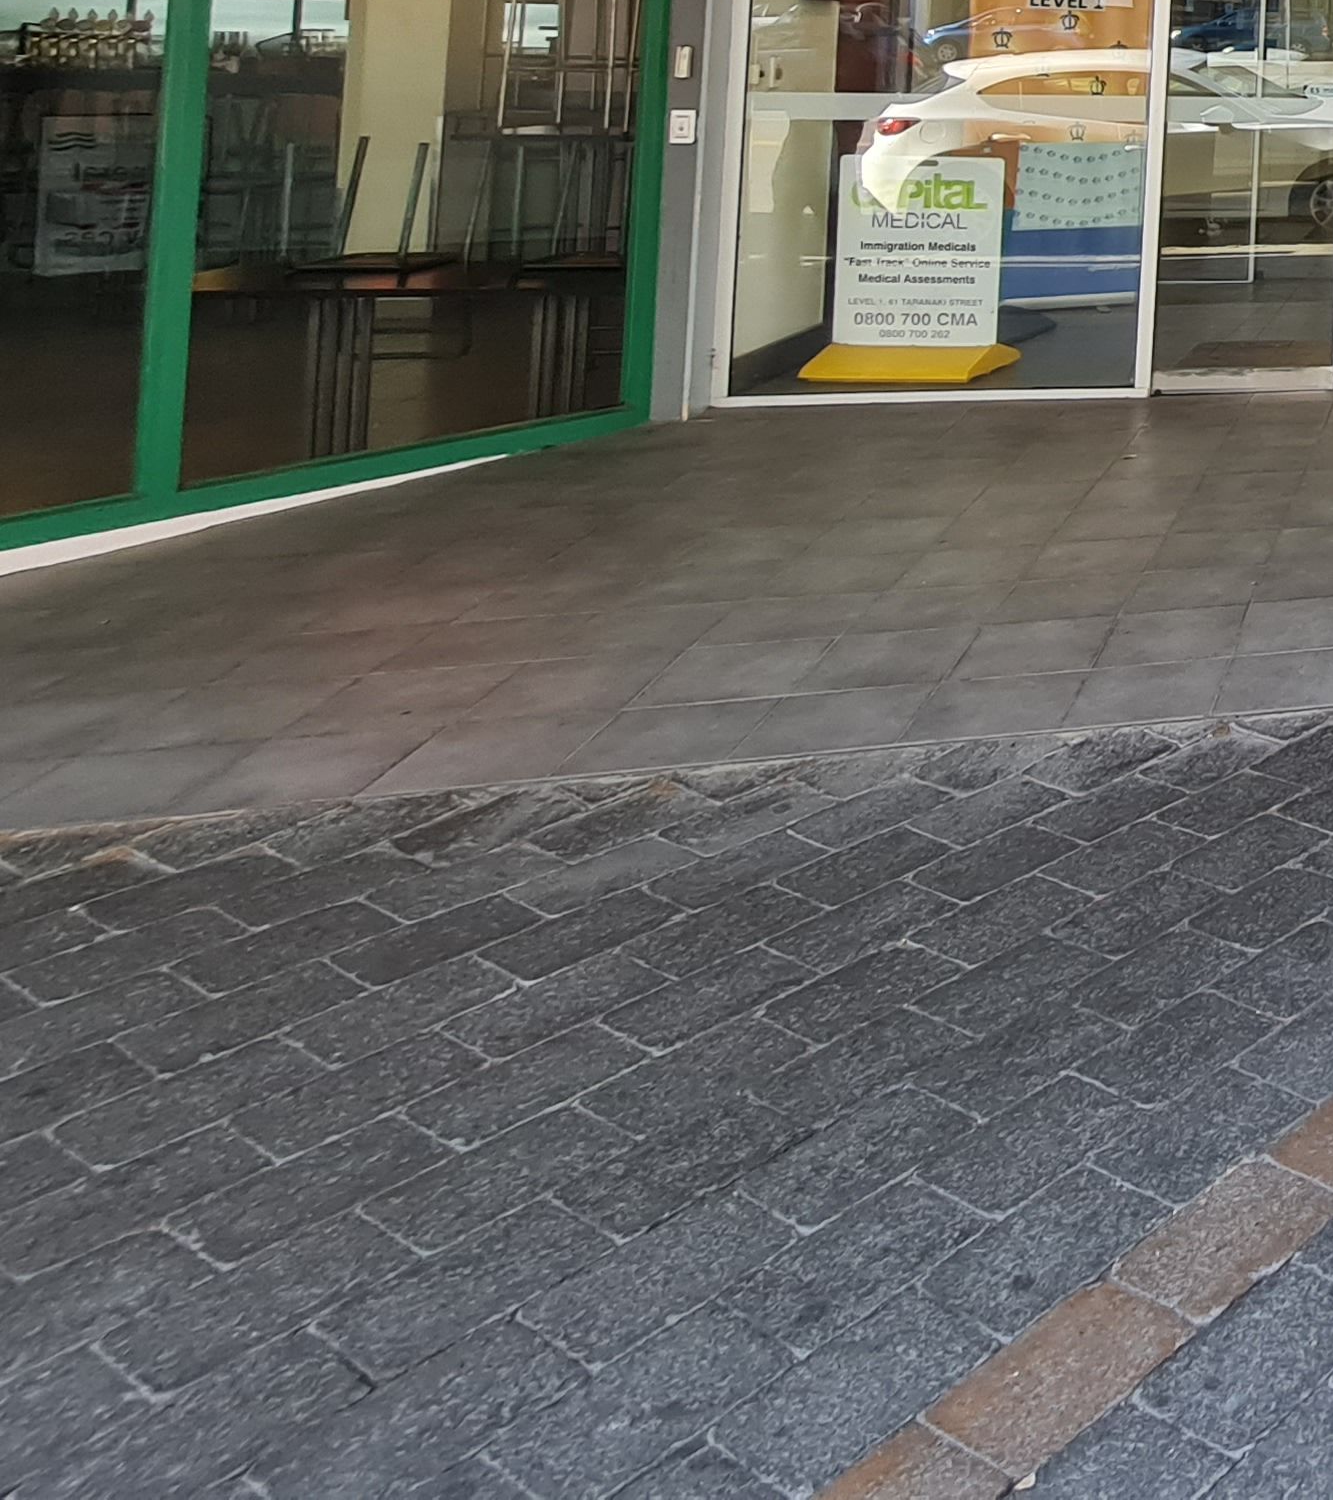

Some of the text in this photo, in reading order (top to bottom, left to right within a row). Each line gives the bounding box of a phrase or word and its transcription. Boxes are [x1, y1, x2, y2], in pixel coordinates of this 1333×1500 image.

[871, 212, 968, 230] MEDICAL
[860, 240, 977, 253] Immigration Medicals
[912, 258, 948, 268] Online
[951, 259, 991, 269] Service
[858, 273, 976, 285] Medical Assessments
[848, 297, 876, 306] LEVEL
[949, 299, 983, 307] STREET
[854, 312, 978, 326] 0800 700 CMA
[879, 329, 906, 339] 0800
[908, 330, 928, 338] 700
